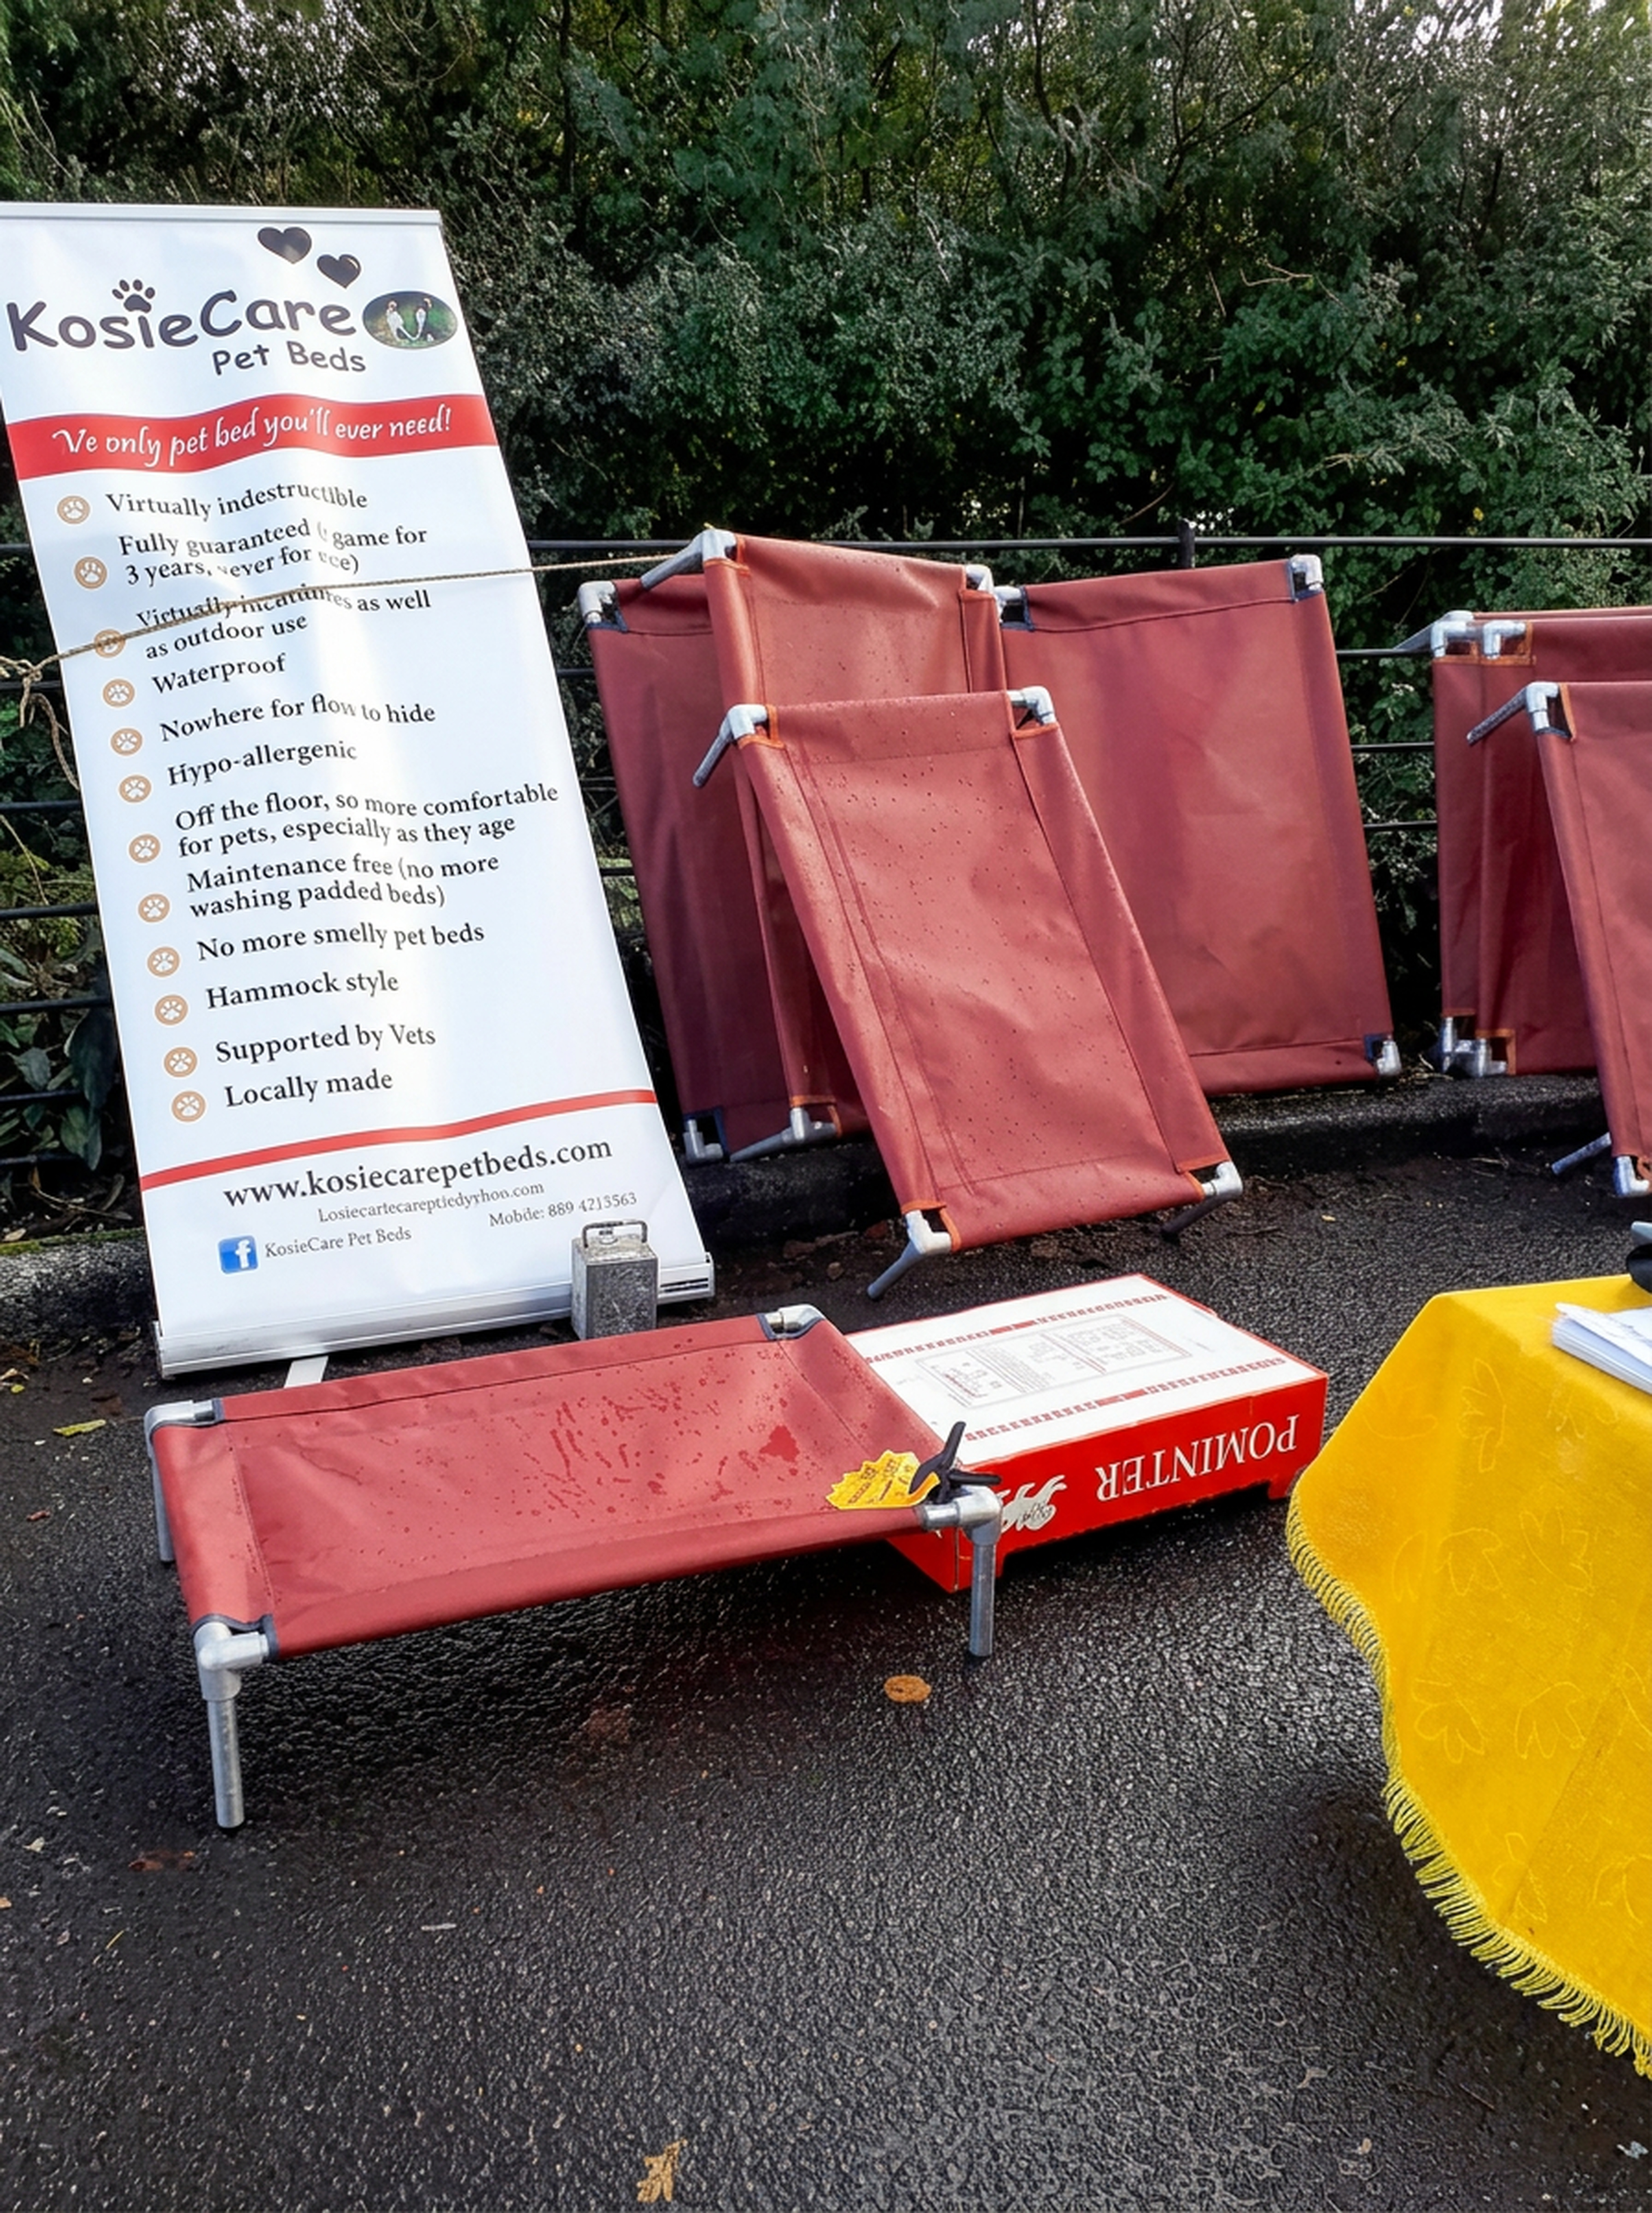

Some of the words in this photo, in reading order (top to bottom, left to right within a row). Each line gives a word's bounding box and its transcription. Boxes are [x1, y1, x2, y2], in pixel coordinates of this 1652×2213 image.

[6, 289, 357, 351] KosieCare
[212, 344, 270, 375] Pet
[287, 340, 366, 371] Beds
[106, 425, 161, 467] only
[169, 426, 208, 467] pet
[216, 407, 259, 447] bed
[263, 407, 330, 447] you'll
[335, 423, 383, 439] ever
[389, 404, 451, 437] need!
[106, 494, 212, 522] Virtually
[119, 533, 179, 556] Fully
[333, 530, 389, 550] game
[395, 525, 427, 544] for
[126, 565, 139, 585] 3
[145, 561, 212, 587] years,
[279, 545, 311, 565] for
[357, 598, 380, 611] as
[386, 589, 431, 608] well
[146, 643, 169, 659] as
[174, 622, 265, 646] outdoor
[271, 615, 308, 635] use
[151, 652, 287, 694] Waterproof
[160, 707, 265, 742] Nowhere
[271, 698, 305, 718] for
[385, 703, 436, 723] hide
[167, 740, 358, 786] Hypo-allergenic
[175, 803, 215, 830] Off
[221, 799, 259, 822] the
[265, 792, 330, 814] floor,
[335, 794, 359, 809] so
[365, 798, 417, 816] more
[423, 783, 559, 816] comfortable
[178, 836, 213, 858] for
[220, 826, 277, 855] pets,
[283, 817, 390, 846] especially
[397, 829, 418, 843] as
[424, 823, 472, 845] they
[478, 816, 516, 840] age
[186, 856, 347, 893] Maintenance
[353, 852, 393, 876] free
[398, 857, 434, 880] (no
[440, 856, 499, 877] more
[189, 889, 292, 917] washing
[298, 880, 383, 908] padded
[386, 883, 446, 907] beds)
[197, 938, 235, 961] No
[242, 930, 307, 954] more
[313, 921, 388, 948] smelly
[393, 927, 427, 950] pet
[431, 922, 485, 946] beds
[205, 971, 342, 1009] Hammock
[346, 969, 399, 997] style
[215, 1024, 351, 1064] Supported
[354, 1024, 384, 1051] by
[388, 1023, 437, 1045] Vets
[224, 1075, 318, 1107] Locally
[326, 1068, 393, 1094] made
[223, 1139, 613, 1207] www.kosiecarepetbeds.com
[264, 1232, 344, 1259] KosieCare
[348, 1227, 372, 1247] Pet
[375, 1225, 412, 1244] Beds
[1095, 1414, 1300, 1502] POMINTER
